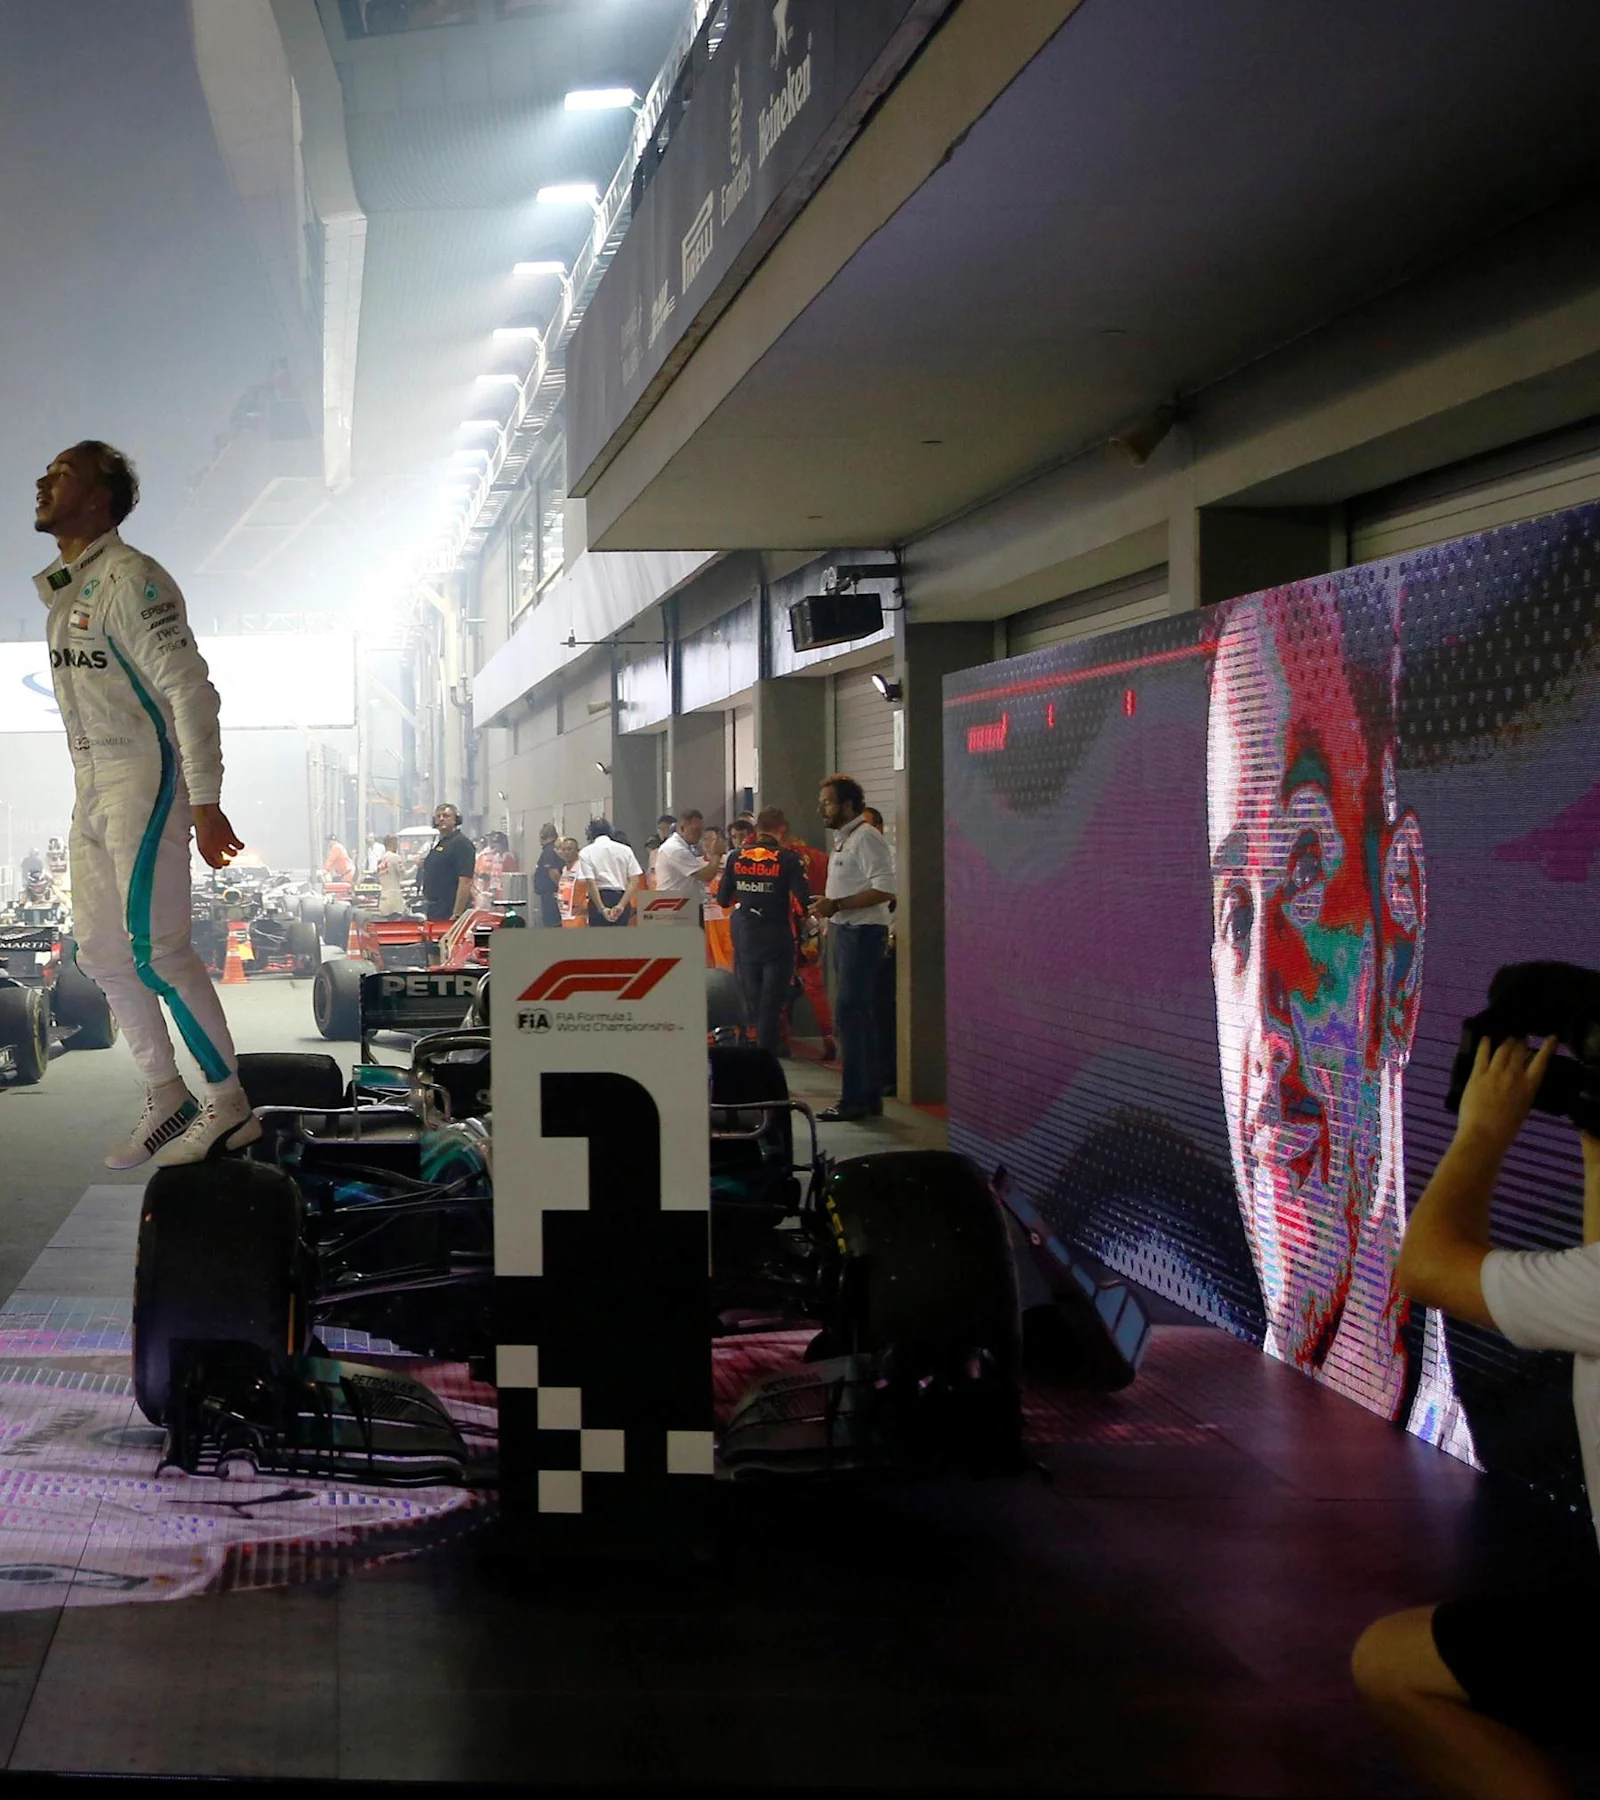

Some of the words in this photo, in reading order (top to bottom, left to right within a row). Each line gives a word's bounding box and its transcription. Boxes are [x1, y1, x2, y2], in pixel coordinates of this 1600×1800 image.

[758, 54, 811, 168] Heineken
[682, 190, 713, 294] PIRELLI
[140, 601, 176, 620] EPSON
[156, 625, 180, 641] IWC
[736, 881, 764, 892] Mobil
[577, 1012, 625, 1021] Formula
[557, 1022, 591, 1032] World
[593, 1022, 675, 1033] Championship
[143, 1108, 190, 1155] PUMA
